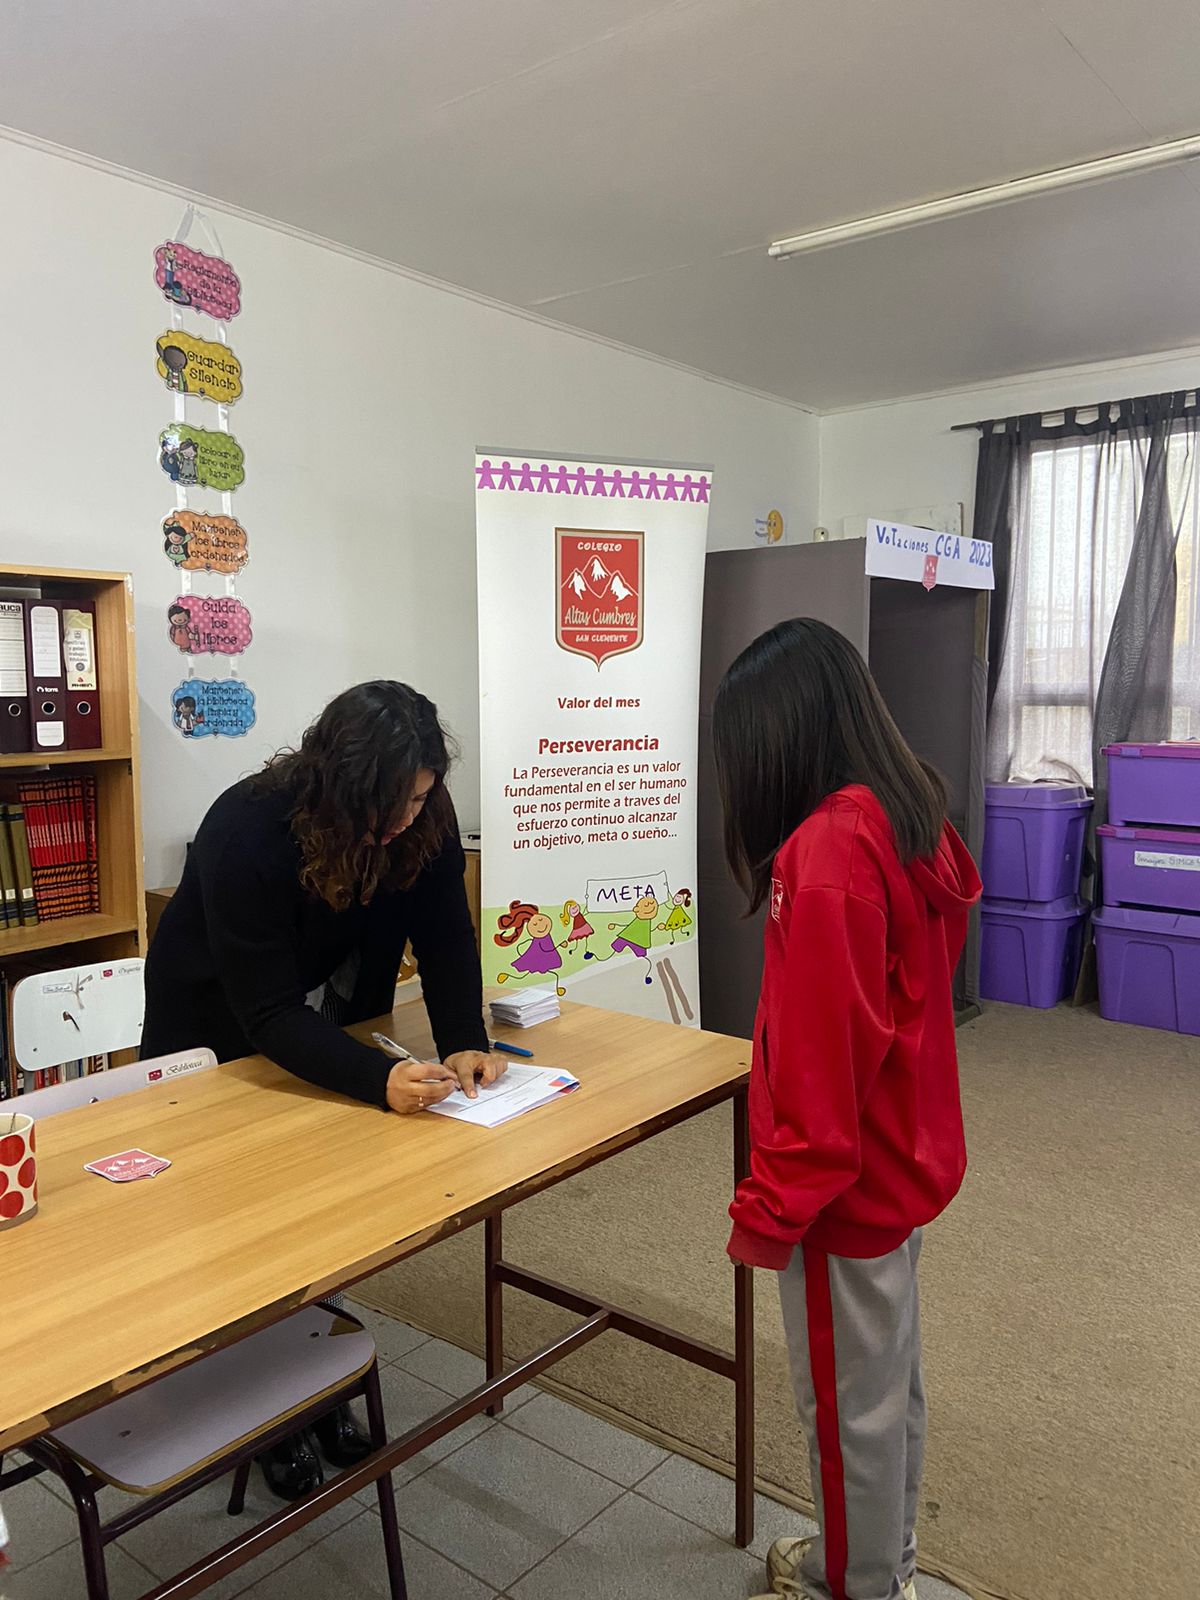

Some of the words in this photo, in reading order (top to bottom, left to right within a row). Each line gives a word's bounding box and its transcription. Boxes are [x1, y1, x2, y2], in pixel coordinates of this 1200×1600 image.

[187, 351, 239, 374] Guardar
[189, 367, 236, 391] Silencio
[192, 521, 241, 537] Mantener
[577, 542, 622, 552] COLEGIO
[935, 534, 960, 560] CGA
[969, 540, 992, 567] 2023
[202, 601, 236, 614] Cuida
[565, 605, 591, 625] Altas
[592, 606, 636, 626] Cumbres
[211, 617, 228, 629] los
[203, 632, 238, 645] libros
[576, 634, 589, 642] SAN
[591, 634, 628, 643] CLEMENTE
[557, 697, 590, 709] Valor
[593, 696, 613, 708] del
[615, 698, 641, 708] mes
[538, 735, 659, 755] Perseverancia
[513, 767, 528, 780] La
[531, 762, 614, 779] Perseverancia
[616, 764, 630, 774] es
[633, 763, 649, 773] un
[652, 760, 681, 772] valor
[504, 781, 583, 798] fundamental
[586, 781, 601, 792] en
[604, 779, 615, 791] el
[618, 780, 637, 791] ser
[639, 778, 687, 790] humano
[512, 803, 538, 818] que
[540, 801, 561, 813] nos
[564, 796, 611, 814] permite
[613, 797, 621, 808] a
[624, 795, 661, 807] traves
[663, 793, 681, 805] del
[517, 818, 568, 832] esfuerzo
[571, 813, 625, 827] continuo
[628, 811, 678, 823] alcanzar
[513, 838, 530, 849] un
[533, 833, 585, 850] objetivo,
[588, 831, 618, 842] meta
[621, 831, 629, 840] o
[632, 827, 677, 840] sueño...
[597, 884, 656, 903] META
